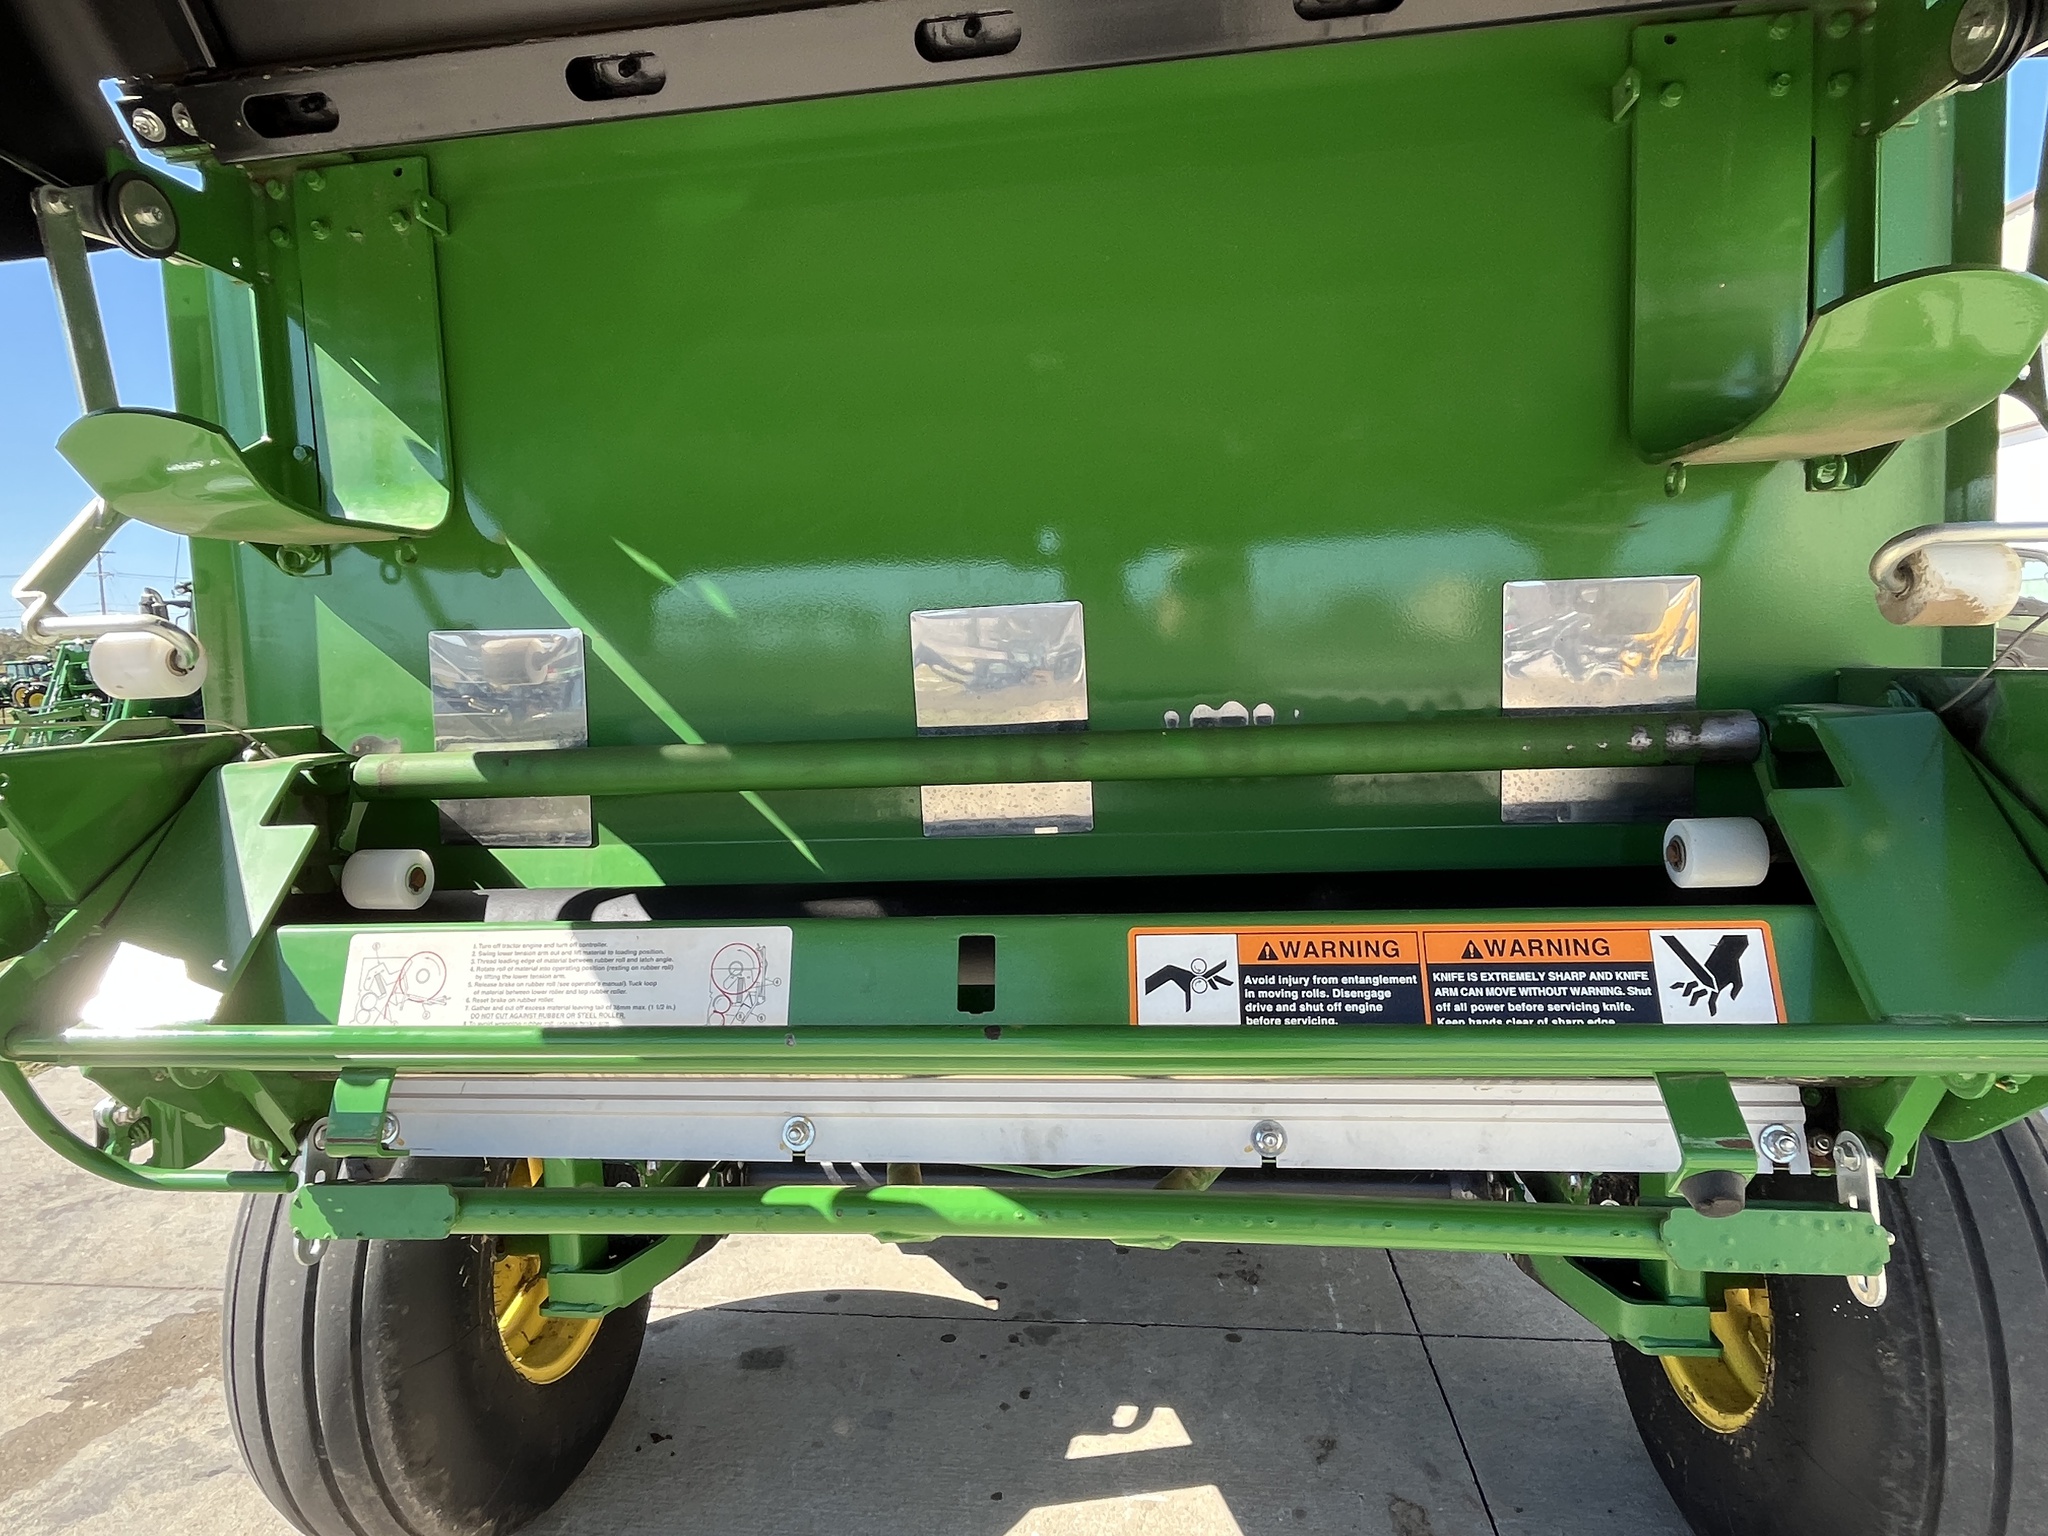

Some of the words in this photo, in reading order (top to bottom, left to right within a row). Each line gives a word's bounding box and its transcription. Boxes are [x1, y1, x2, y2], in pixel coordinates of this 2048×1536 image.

[1279, 940, 1399, 959] WARNING
[1484, 937, 1610, 957] WARNING
[1244, 975, 1275, 985] Avoid
[1279, 975, 1309, 986] injury
[1312, 975, 1338, 984] from
[1341, 975, 1417, 986] entanglement
[1432, 972, 1465, 983] KNIFE
[1467, 972, 1478, 982] IS
[1480, 971, 1545, 982] EXTREMELY
[1548, 971, 1586, 981] SHARP
[1589, 971, 1613, 981] AND
[1616, 971, 1649, 981] KNIFE
[1245, 989, 1255, 998] in
[1258, 989, 1298, 999] moving
[1301, 989, 1329, 998] rolls.
[1332, 989, 1391, 999] Disengage
[1434, 987, 1459, 997] ARM
[1460, 987, 1483, 997] CAN
[1486, 987, 1517, 997] MOVE
[1519, 987, 1568, 997] WITHOUT
[1570, 986, 1626, 996] WARNING.
[1627, 986, 1652, 996] Shut
[1245, 1002, 1273, 1012] drive
[1275, 1002, 1296, 1012] and
[1299, 1002, 1324, 1012] shut
[1327, 1002, 1341, 1012] off
[1344, 1003, 1383, 1013] engine
[1436, 1002, 1451, 1012] off
[1454, 1002, 1467, 1012] all
[1470, 1004, 1505, 1014] power
[1508, 1002, 1545, 1012] before
[1548, 1002, 1600, 1013] servicing
[1603, 1001, 1635, 1012] knife.
[1246, 1016, 1281, 1025] before
[1468, 1017, 1502, 1025] hands
[1506, 1017, 1534, 1025] clear
[1537, 1017, 1548, 1025] of
